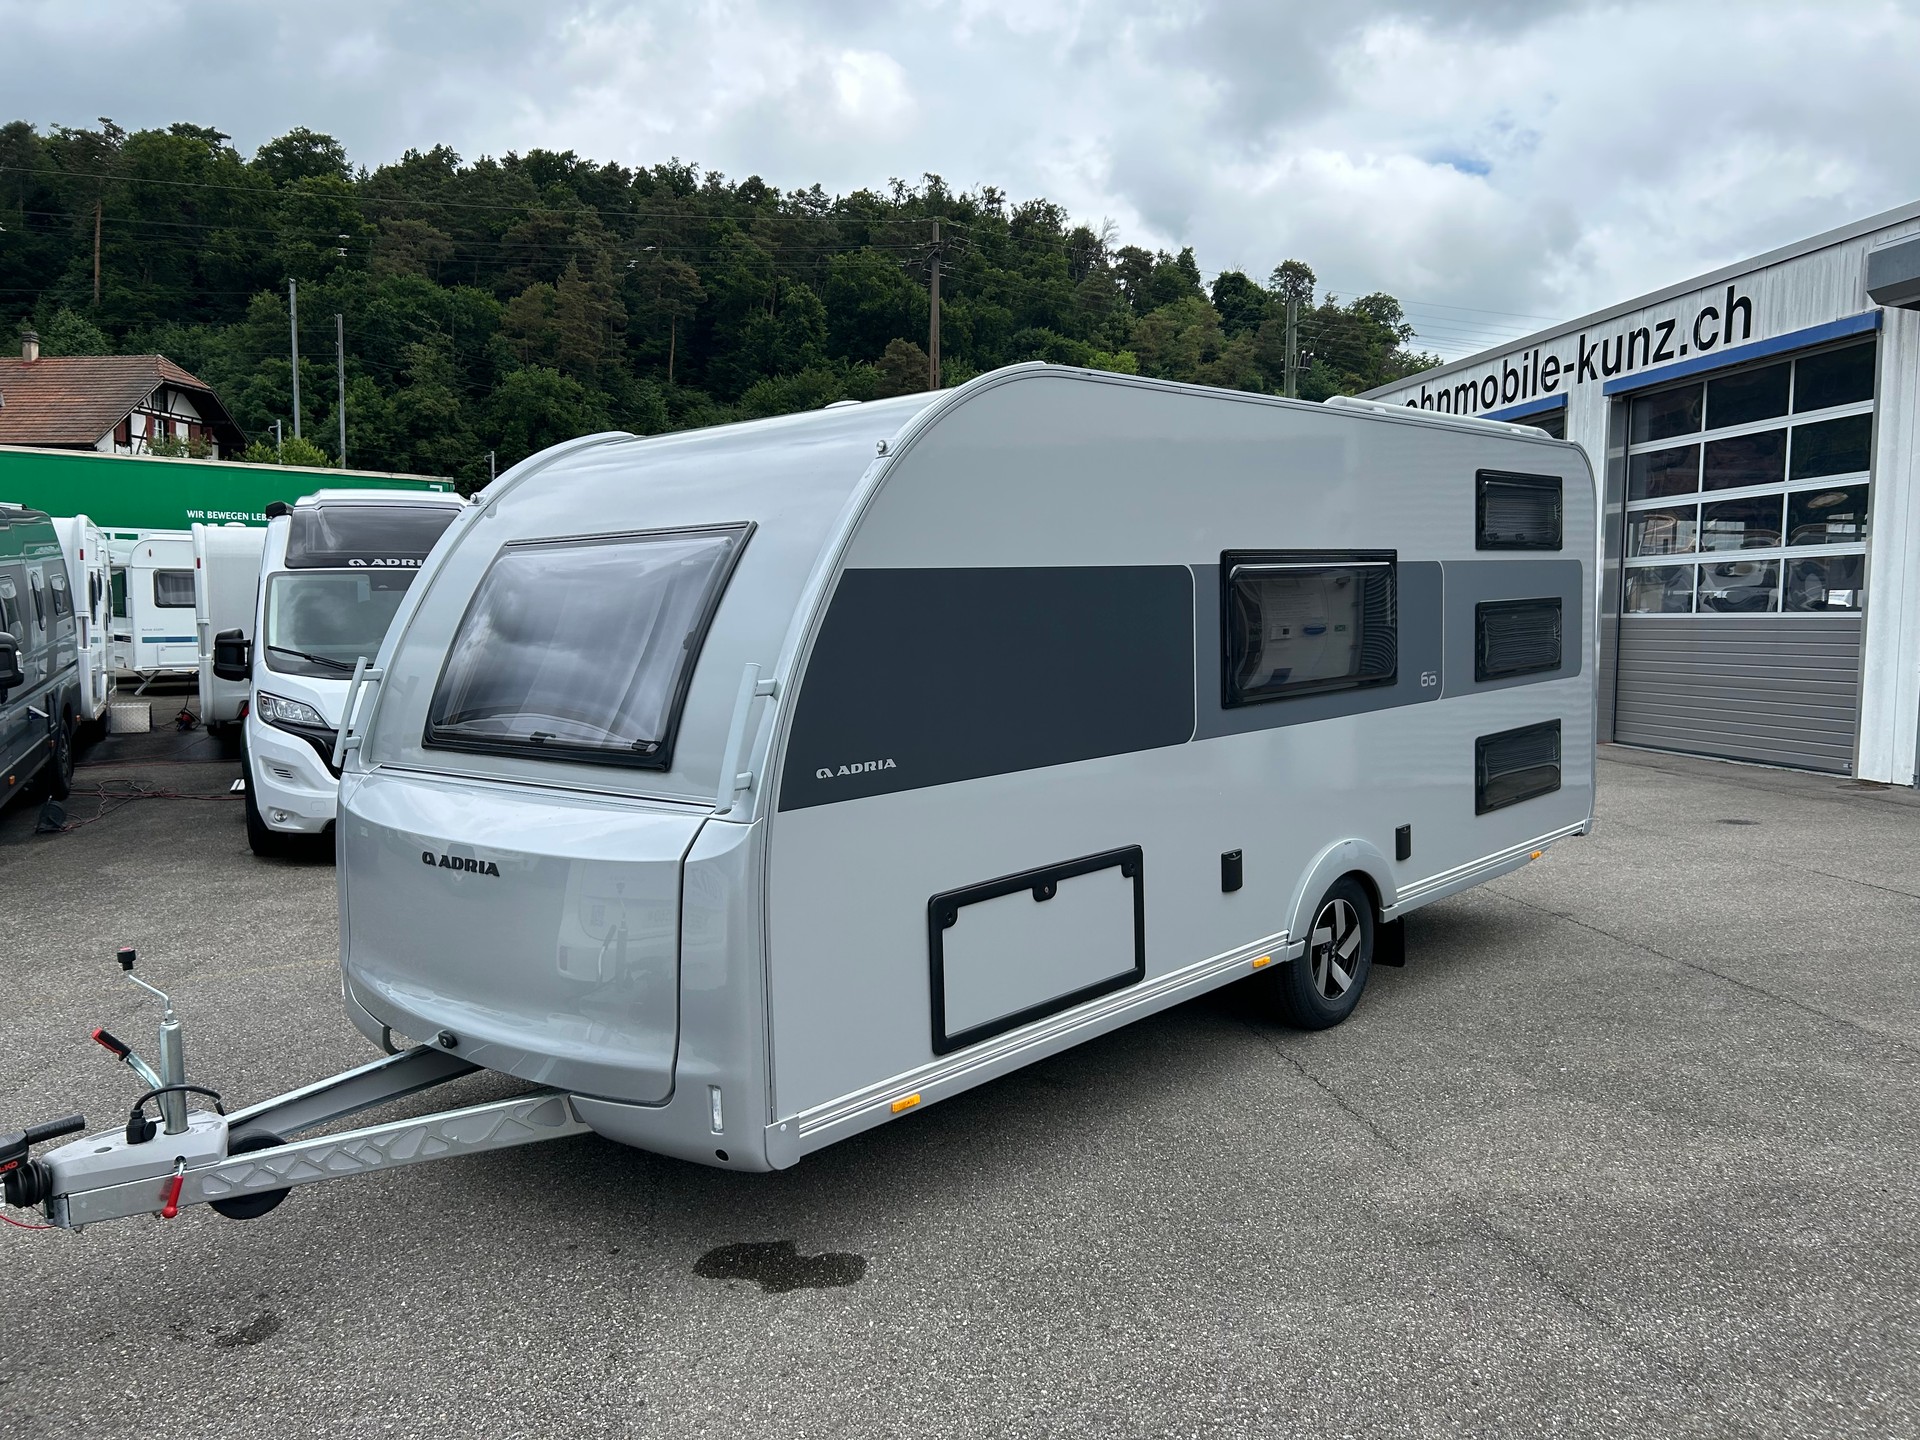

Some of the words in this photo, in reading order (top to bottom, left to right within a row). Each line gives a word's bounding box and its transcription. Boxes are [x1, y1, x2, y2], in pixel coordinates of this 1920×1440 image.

[187, 510, 205, 519] WIR
[207, 511, 249, 520] BEWEGEN
[836, 758, 897, 777] ADRIA
[438, 854, 500, 877] ADRIA
